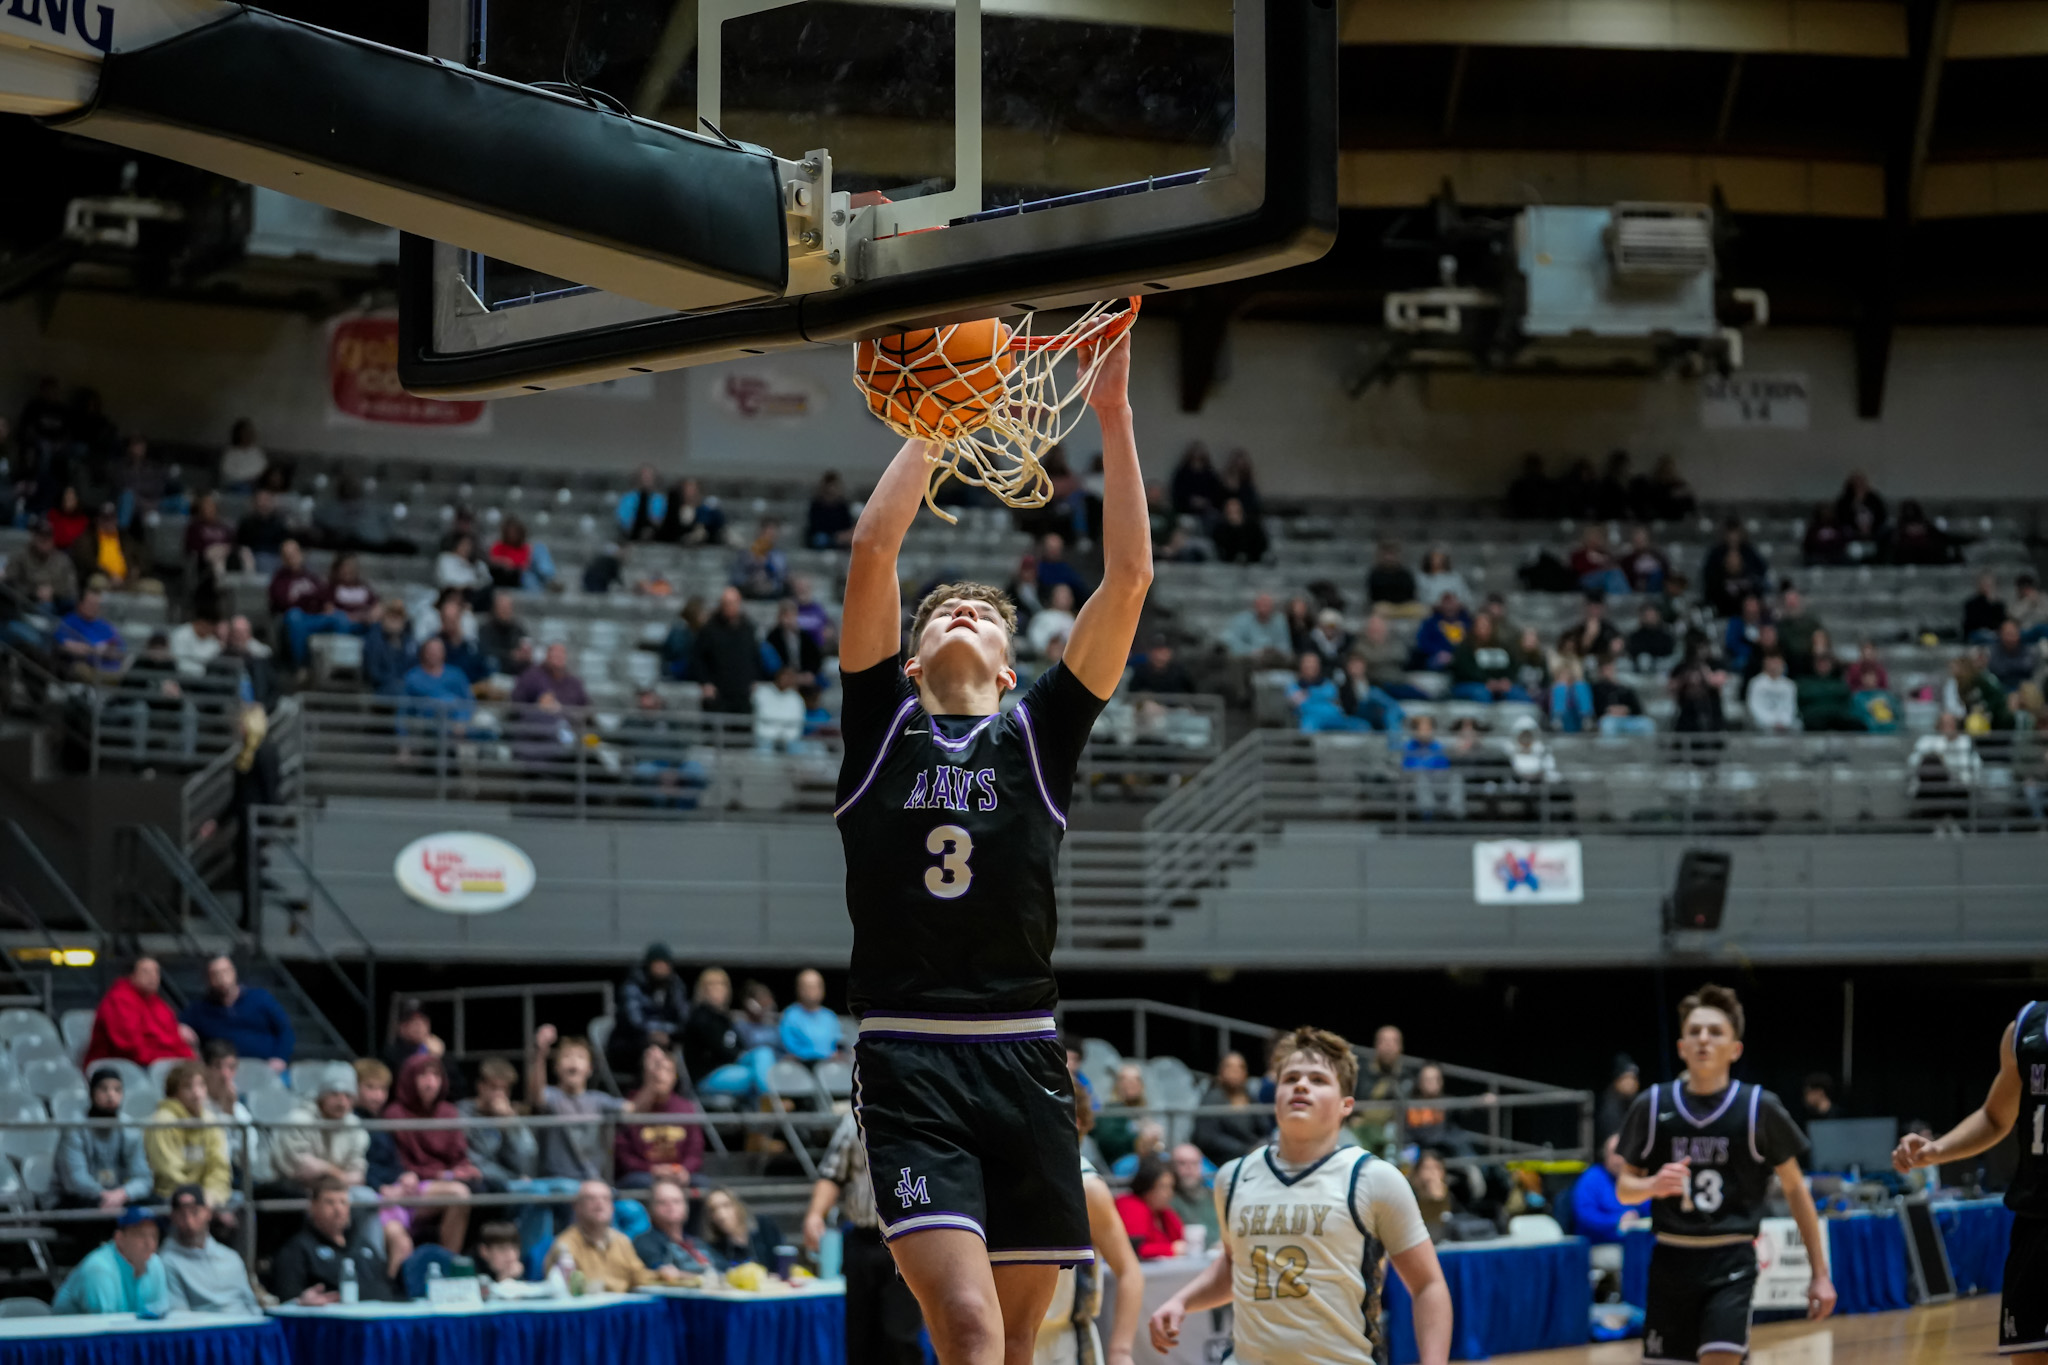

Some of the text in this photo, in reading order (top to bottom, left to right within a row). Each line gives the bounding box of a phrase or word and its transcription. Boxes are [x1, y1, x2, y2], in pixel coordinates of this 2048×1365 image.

[903, 765, 998, 812] MAVS
[924, 823, 974, 899] 3
[1671, 1136, 1730, 1165] MAVS
[1680, 1168, 1724, 1213] 13
[1237, 1203, 1332, 1238] SHADY
[1251, 1245, 1311, 1300] 12
